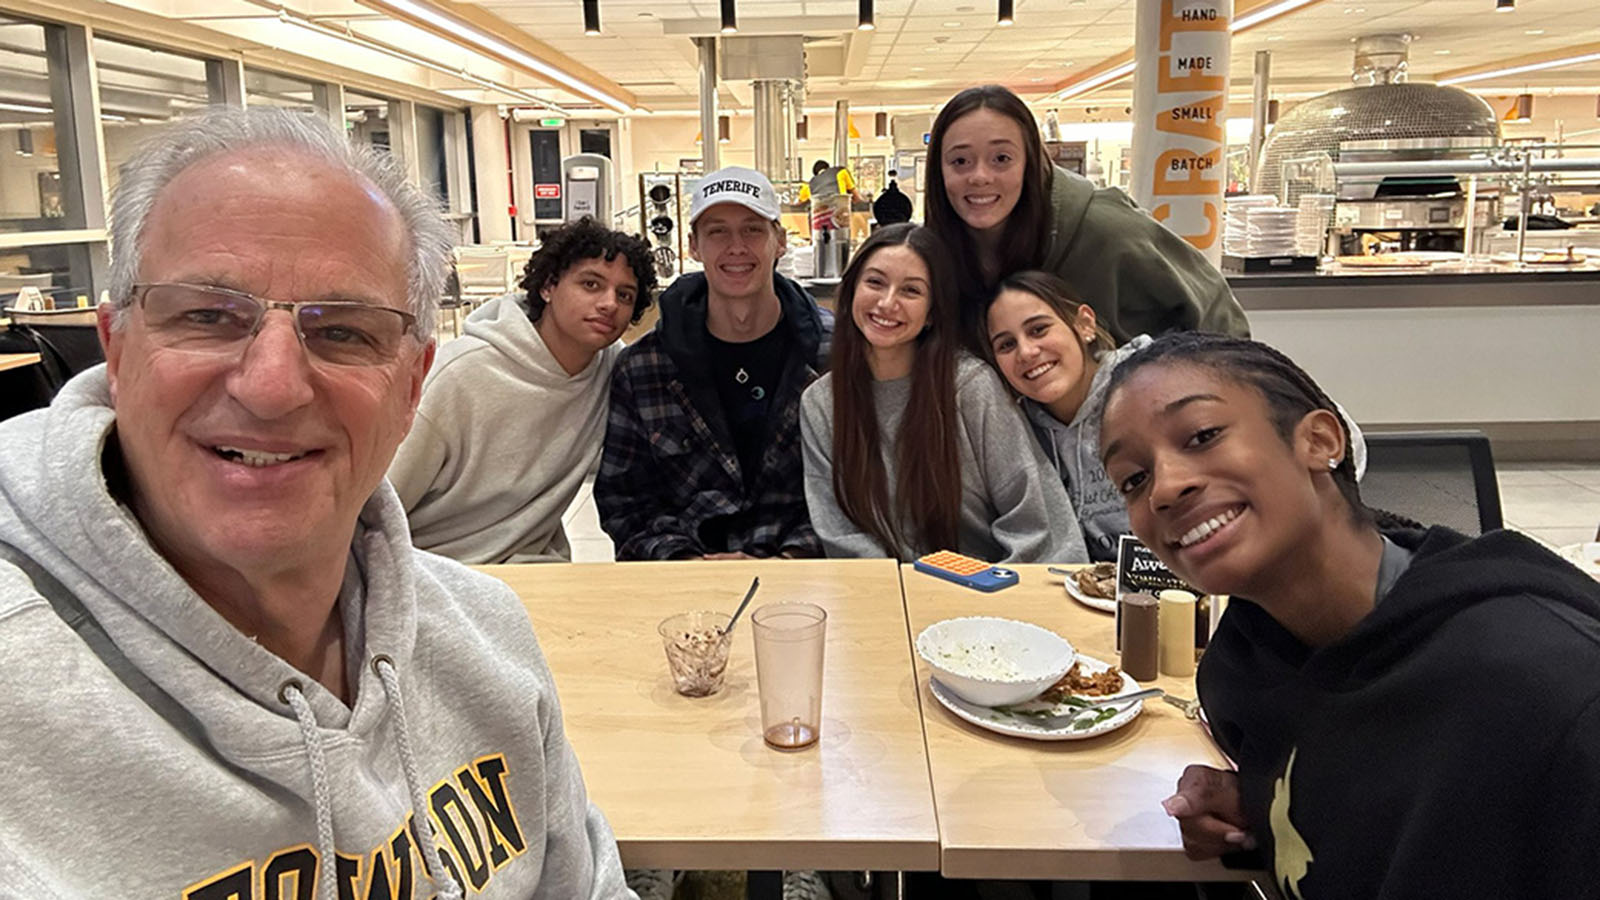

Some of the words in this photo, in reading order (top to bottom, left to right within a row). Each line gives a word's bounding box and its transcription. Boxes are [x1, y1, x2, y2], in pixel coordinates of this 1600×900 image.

[1182, 8, 1217, 22] HAND
[1178, 56, 1212, 70] MADE
[1172, 107, 1212, 121] SMALL
[1153, 0, 1228, 250] CRAFT
[1171, 157, 1213, 172] BATCH
[703, 179, 761, 199] TENERIFE
